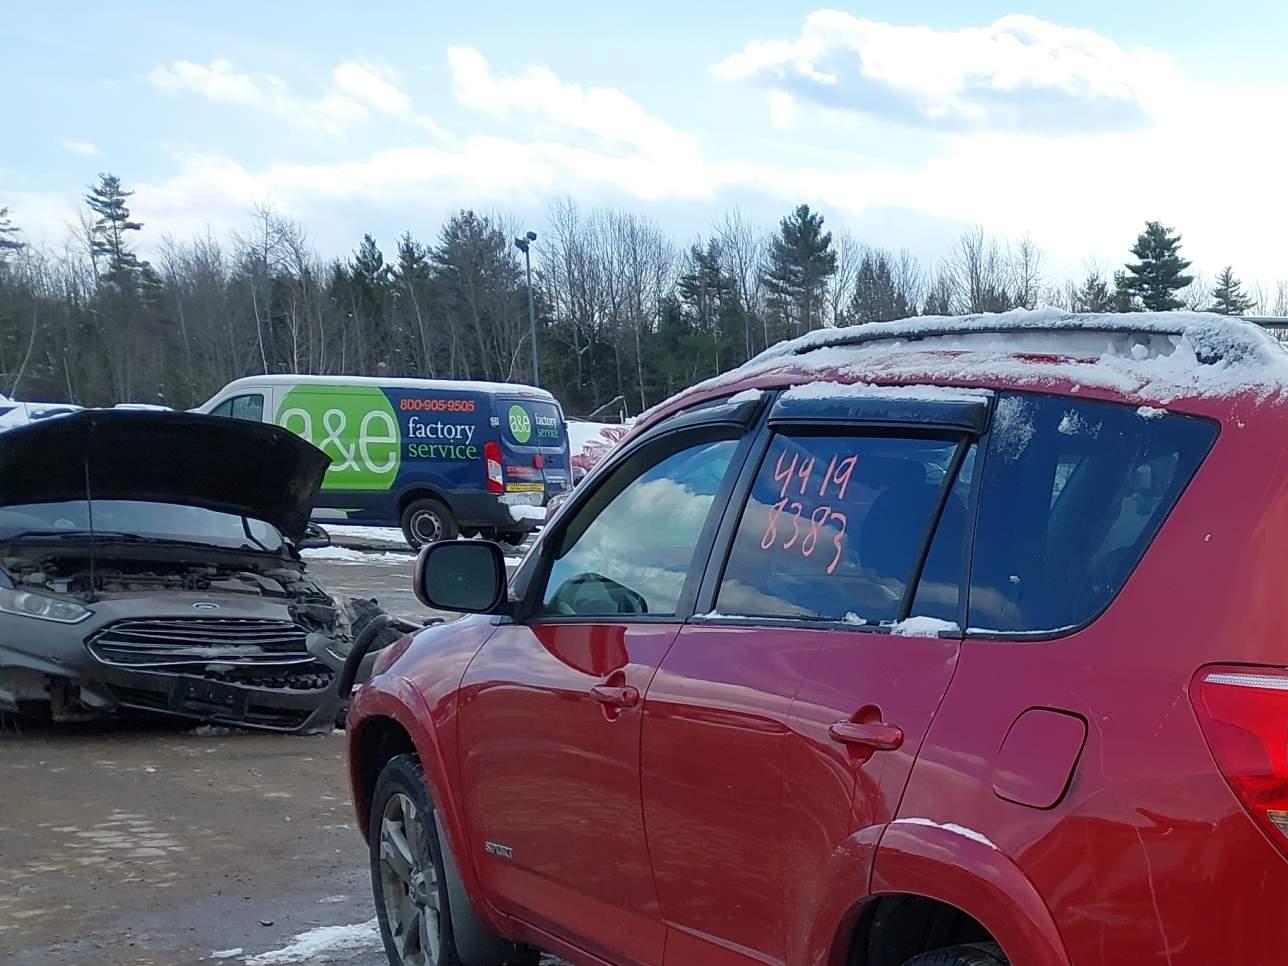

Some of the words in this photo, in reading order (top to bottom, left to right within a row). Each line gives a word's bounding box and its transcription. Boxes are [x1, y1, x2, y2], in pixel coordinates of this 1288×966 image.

[408, 416, 475, 445] factory
[535, 412, 557, 429] factory
[537, 427, 559, 439] service
[408, 443, 477, 460] service
[775, 448, 858, 500] 4419
[761, 498, 847, 573] 8383
